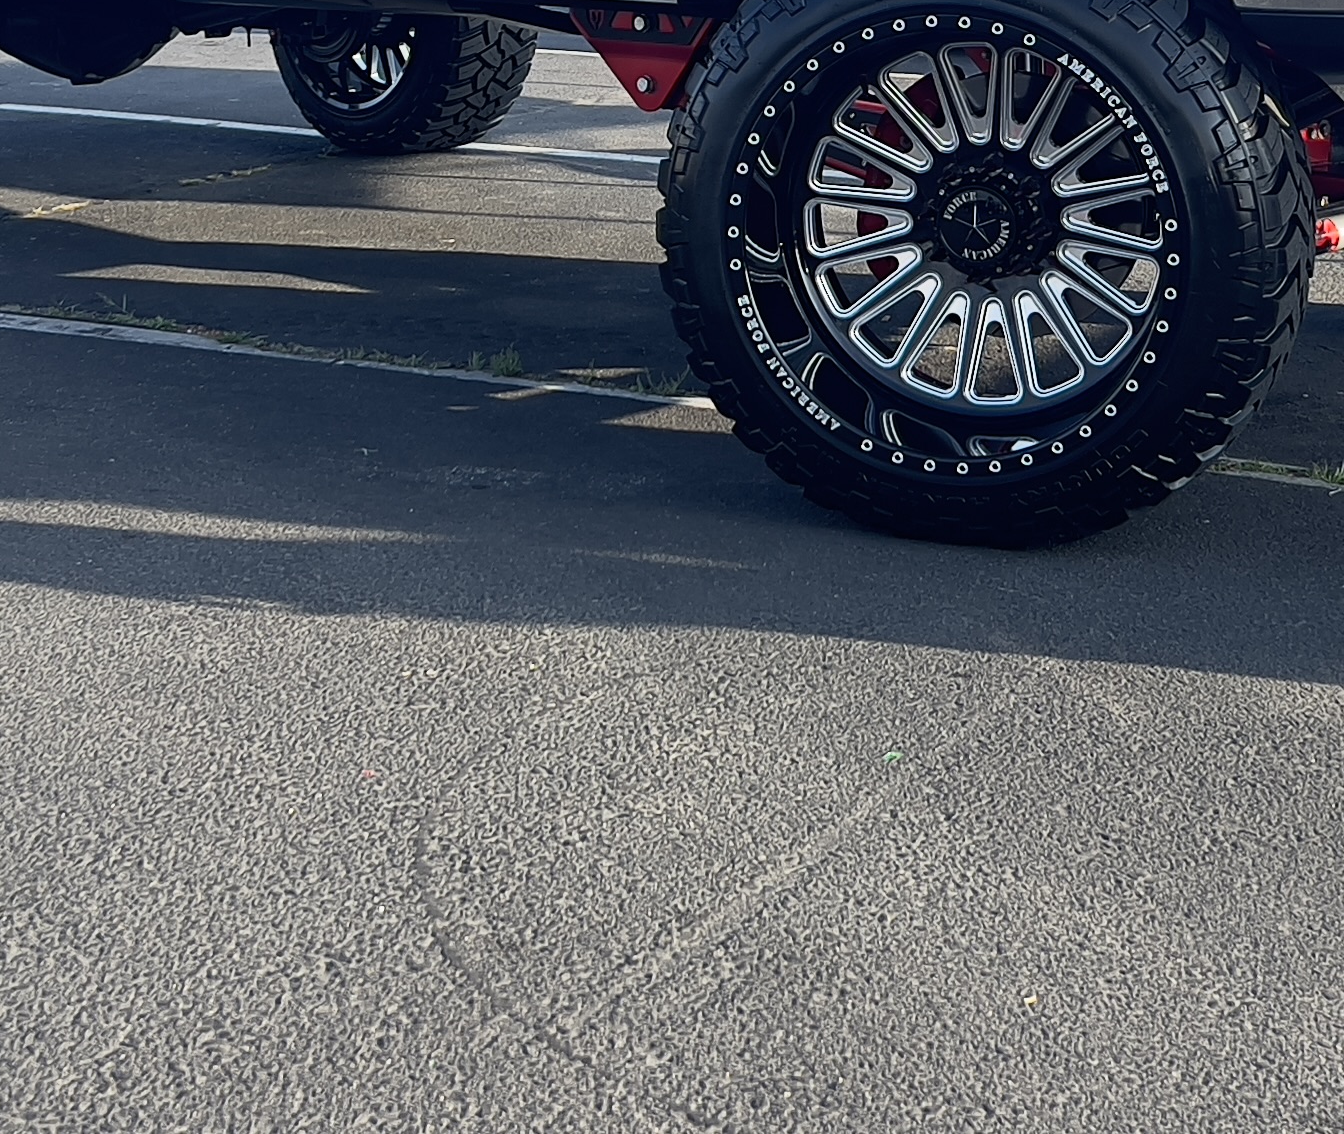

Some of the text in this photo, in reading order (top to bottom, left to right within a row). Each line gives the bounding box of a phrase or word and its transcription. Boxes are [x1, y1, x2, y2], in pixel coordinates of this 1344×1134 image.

[1057, 53, 1169, 194] AMERICAN FORCE
[943, 191, 977, 220] FORCE
[737, 294, 841, 431] AMERICAN FORCE
